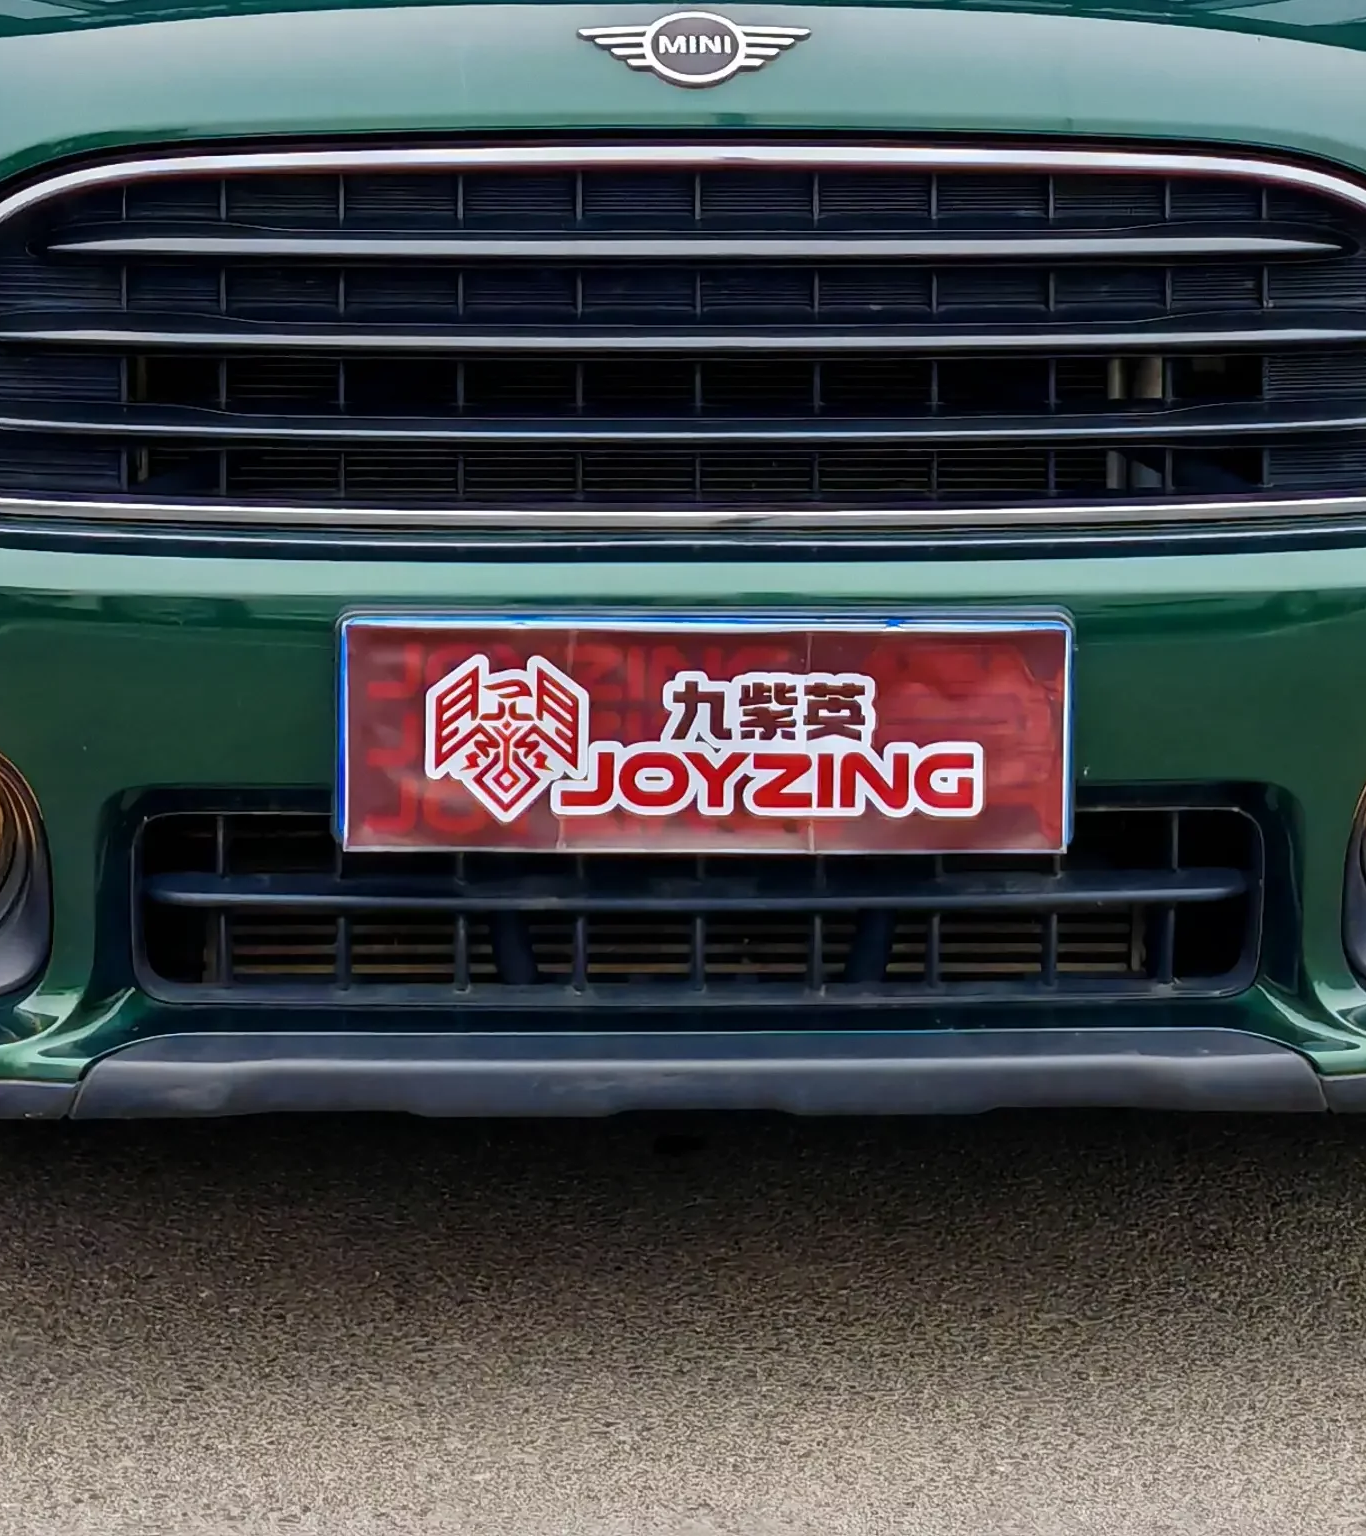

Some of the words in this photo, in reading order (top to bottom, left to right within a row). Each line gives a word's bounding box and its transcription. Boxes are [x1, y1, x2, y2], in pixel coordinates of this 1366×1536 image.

[657, 34, 732, 55] MINI
[670, 680, 866, 742] 九紫英
[560, 751, 975, 810] JOYZING
